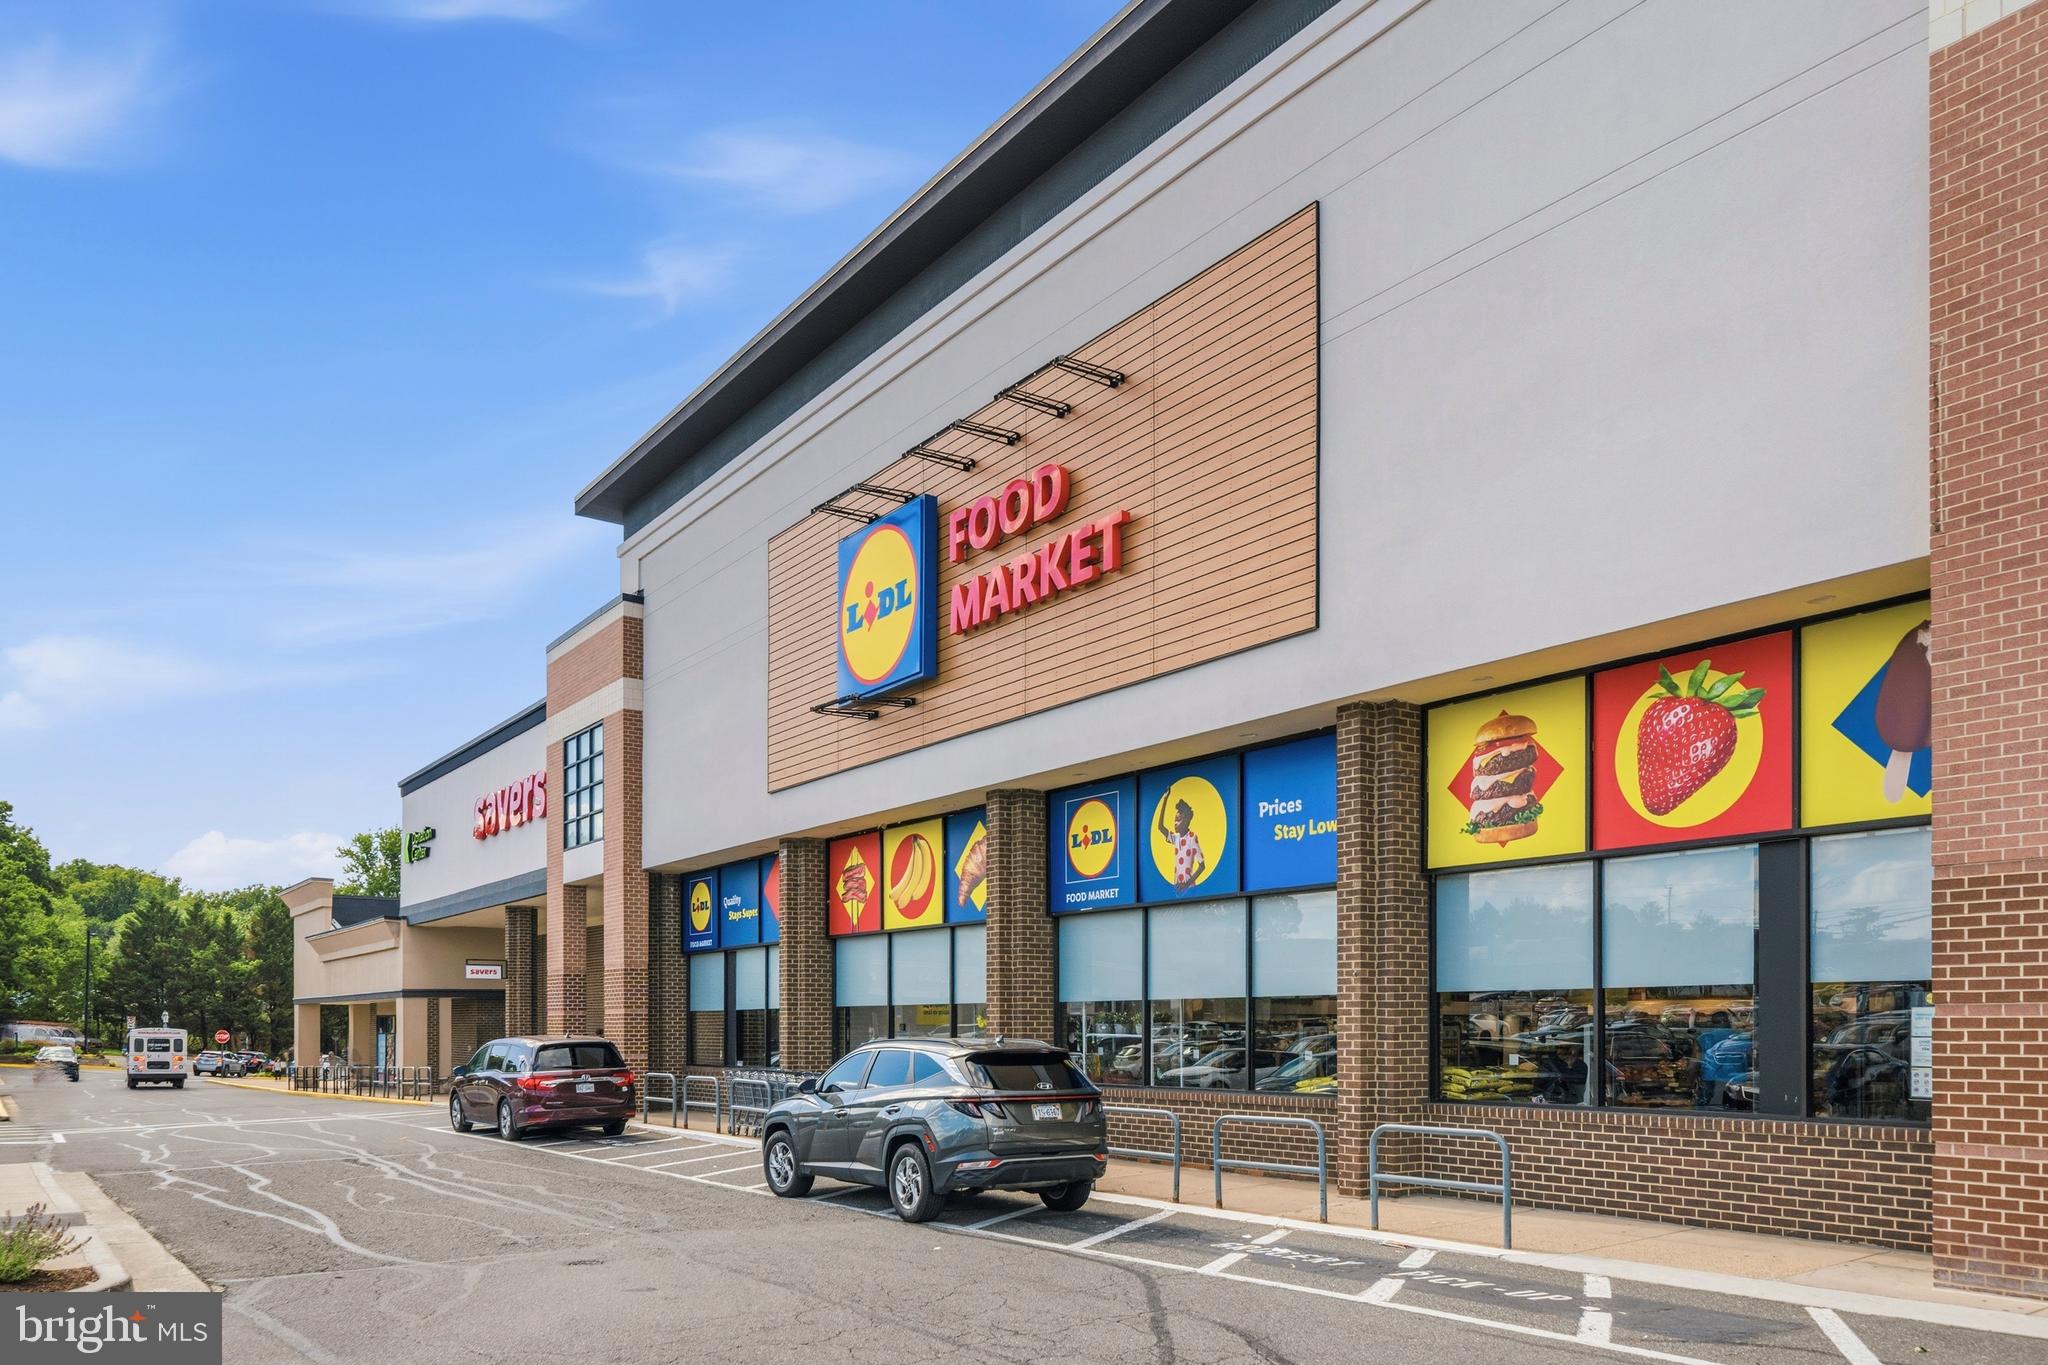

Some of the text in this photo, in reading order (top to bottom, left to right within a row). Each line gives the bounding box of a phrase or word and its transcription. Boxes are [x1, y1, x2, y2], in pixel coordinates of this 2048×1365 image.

[949, 464, 1071, 564] FOOD
[950, 510, 1131, 636] MARKET
[1259, 798, 1303, 818] Prices
[1274, 823, 1305, 842] Stay
[1066, 888, 1120, 904] FOOD MARKET
[1388, 1270, 1573, 1301] PICK-UP
